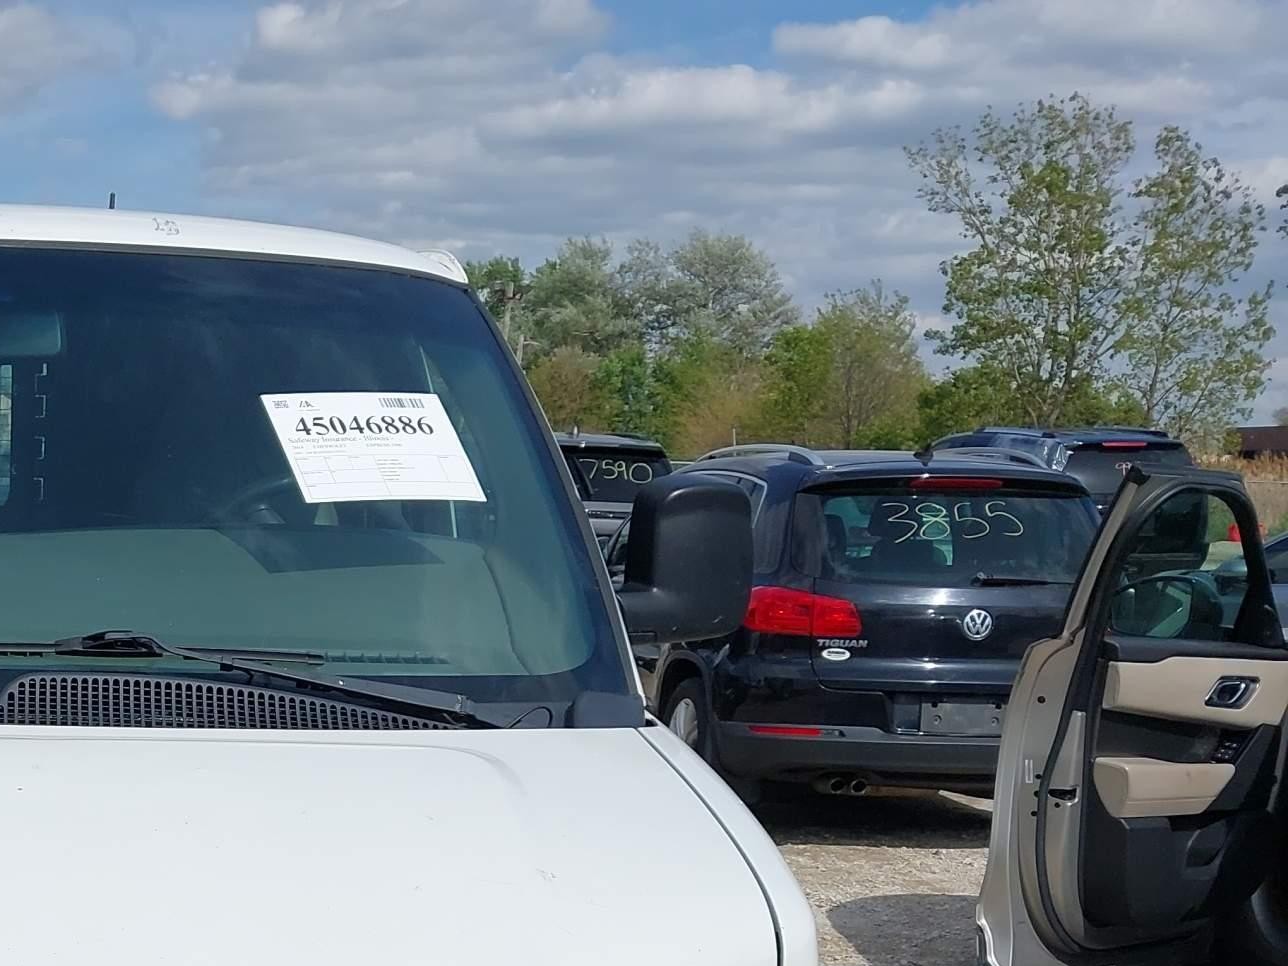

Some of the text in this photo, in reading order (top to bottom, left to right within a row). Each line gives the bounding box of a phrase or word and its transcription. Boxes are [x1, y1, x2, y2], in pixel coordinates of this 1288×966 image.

[295, 415, 434, 436] 45046886
[579, 458, 652, 484] 7590
[882, 500, 1024, 543] 3855
[816, 639, 868, 648] TIGUAN
